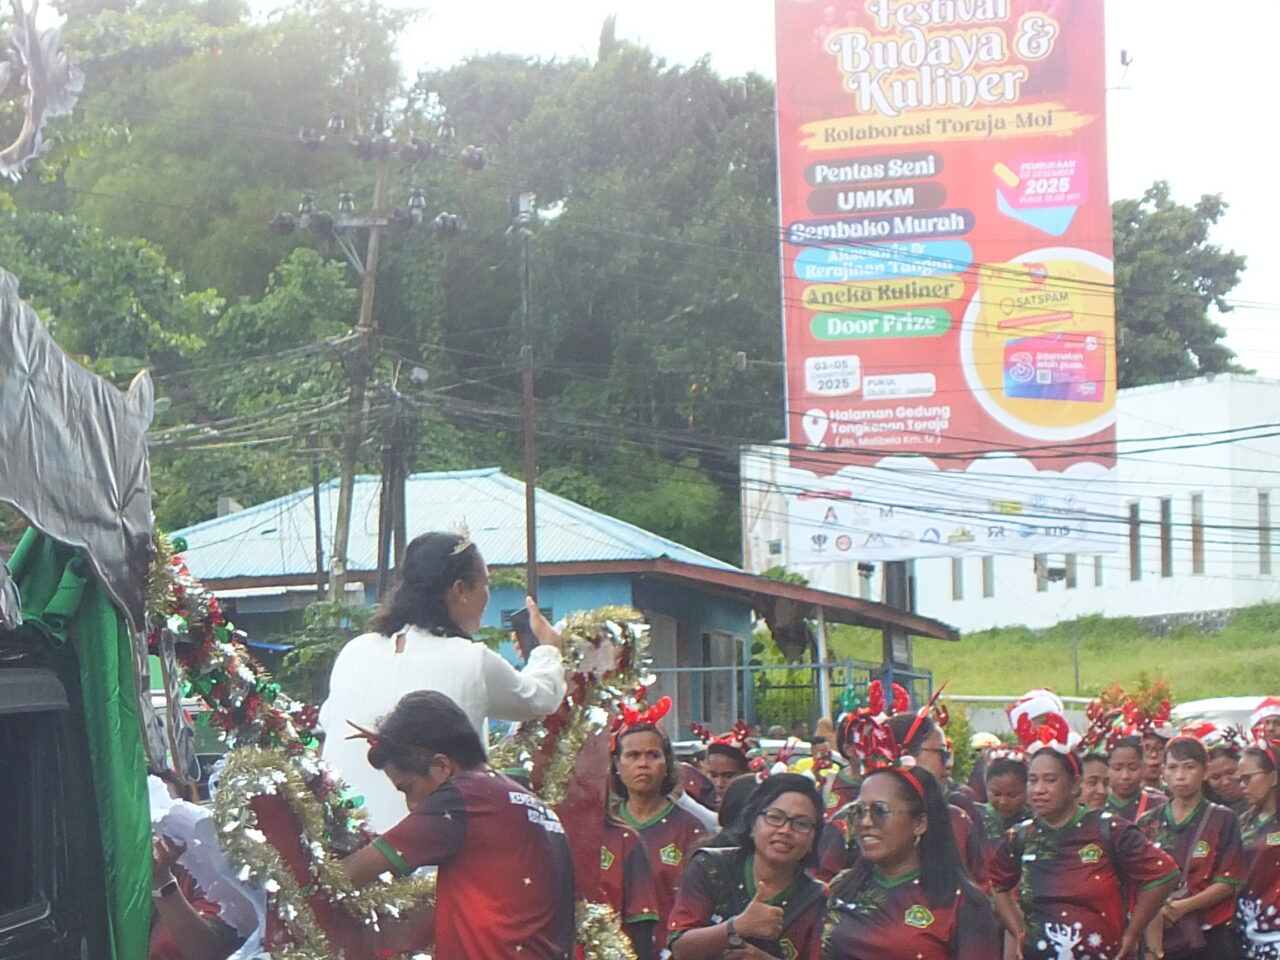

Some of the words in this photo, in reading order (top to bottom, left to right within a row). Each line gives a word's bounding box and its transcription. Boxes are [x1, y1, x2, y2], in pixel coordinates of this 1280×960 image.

[869, 0, 1008, 29] Festival
[830, 26, 1005, 76] Budaya
[1017, 16, 1057, 60] &
[847, 65, 1026, 118] Kuliner
[824, 119, 932, 143] Kolaborasi
[815, 162, 886, 183] Pentas
[887, 154, 936, 178] Seni
[837, 186, 915, 211] UMKM
[1023, 177, 1071, 196] 2025
[893, 212, 966, 234] Murah
[807, 286, 873, 305] Aneka
[877, 281, 955, 301] Kuliner
[826, 317, 880, 336] Door
[882, 312, 937, 333] Prize
[817, 378, 851, 391] 2025
[829, 408, 894, 421] Halaman
[895, 405, 951, 420] Gedung
